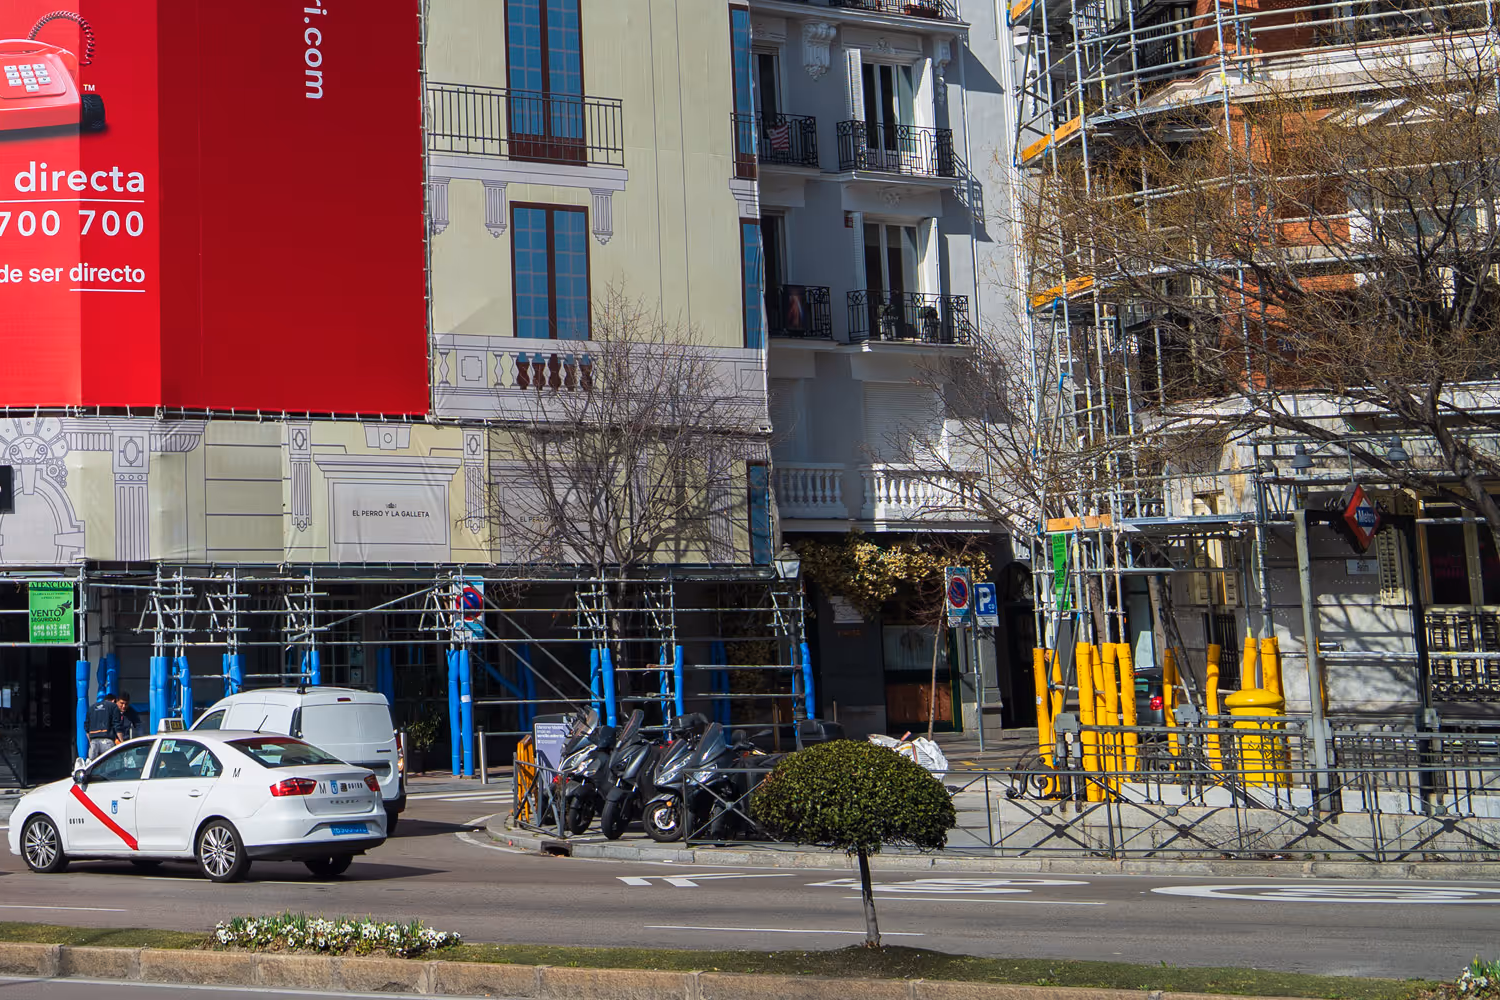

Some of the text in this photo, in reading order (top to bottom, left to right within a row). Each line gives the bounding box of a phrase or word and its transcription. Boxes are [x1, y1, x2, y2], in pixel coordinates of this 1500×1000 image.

[14, 160, 145, 193] directa
[78, 209, 144, 237] 700
[29, 267, 64, 283] ser
[68, 262, 146, 283] directo
[352, 509, 360, 517] EL
[391, 510, 400, 518] LA
[31, 609, 62, 617] VENTO
